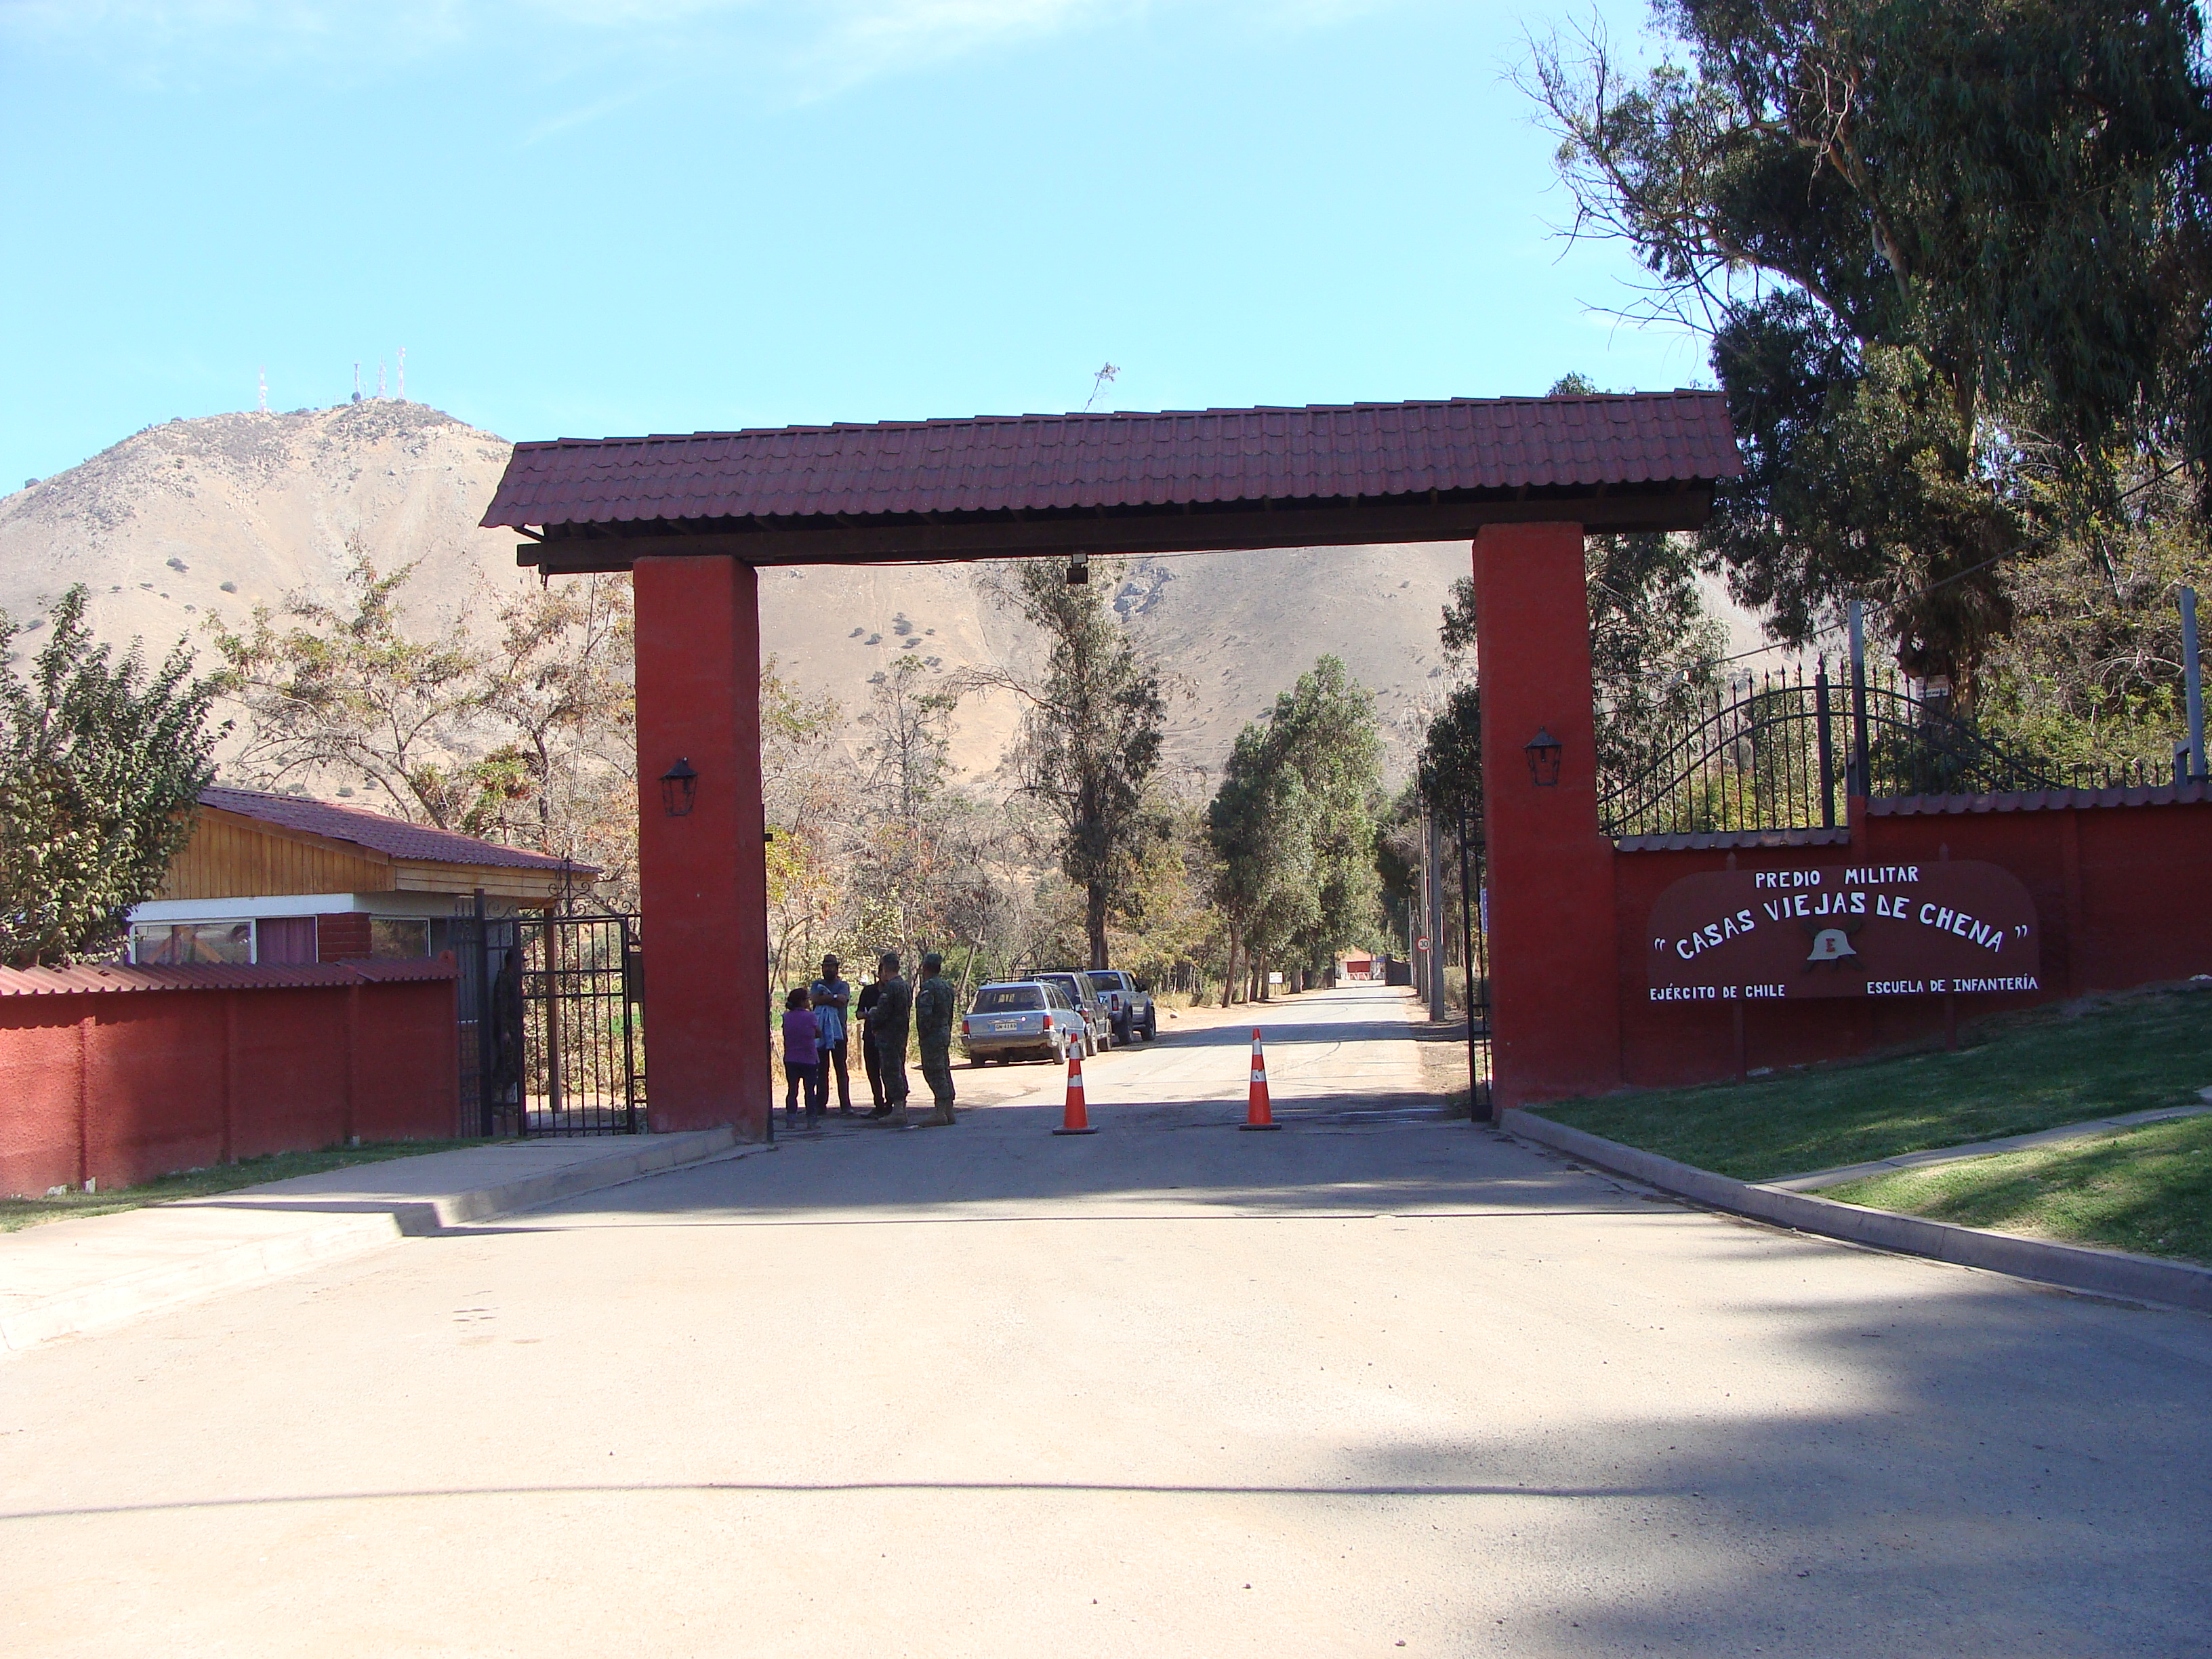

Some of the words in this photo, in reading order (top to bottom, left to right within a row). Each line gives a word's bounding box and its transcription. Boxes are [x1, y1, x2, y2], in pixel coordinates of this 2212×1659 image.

[1755, 870, 1820, 888] PREDIO
[1845, 866, 1919, 884] MILITAR
[1676, 909, 1755, 960] CASAS
[1763, 892, 1866, 922] VIEJAS
[1876, 894, 1910, 919] DE
[1919, 903, 2003, 954] CHENA
[1650, 983, 1715, 1000] EJÉRCITO
[1723, 985, 1737, 998] DE
[1745, 984, 1786, 998] CHILE
[1867, 980, 1923, 994] ESCUELA
[1930, 979, 1946, 991] DE
[1952, 972, 2039, 991] INFANTERÍA
